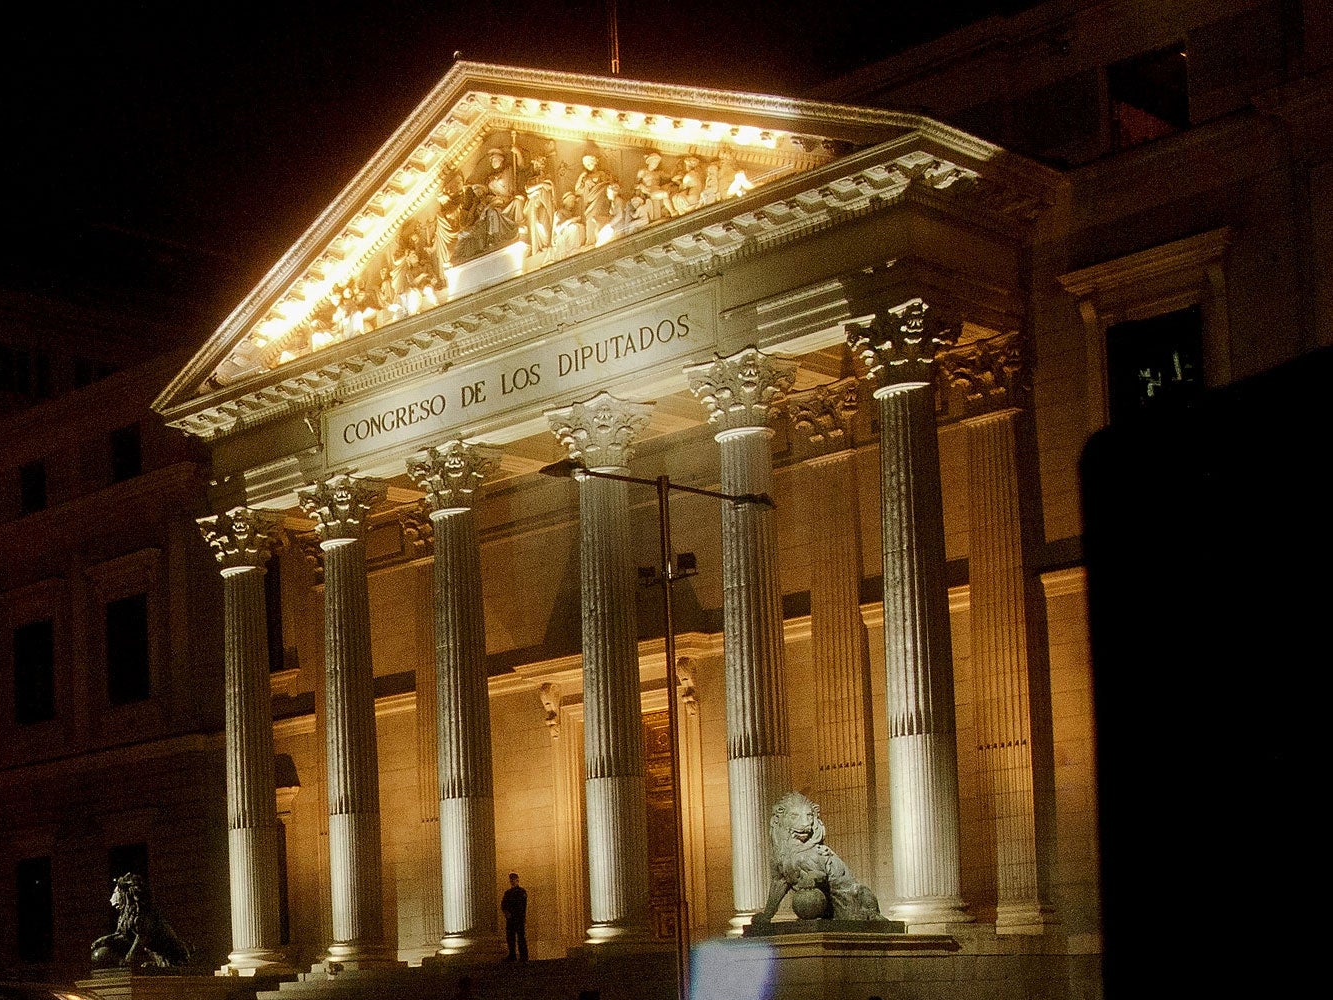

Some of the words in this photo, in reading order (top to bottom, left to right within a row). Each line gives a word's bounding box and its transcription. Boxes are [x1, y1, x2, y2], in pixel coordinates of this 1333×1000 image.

[343, 394, 446, 444] CONGRESO
[461, 380, 487, 408] DE
[501, 364, 542, 395] LOS
[559, 313, 691, 377] DIPUTADOS
